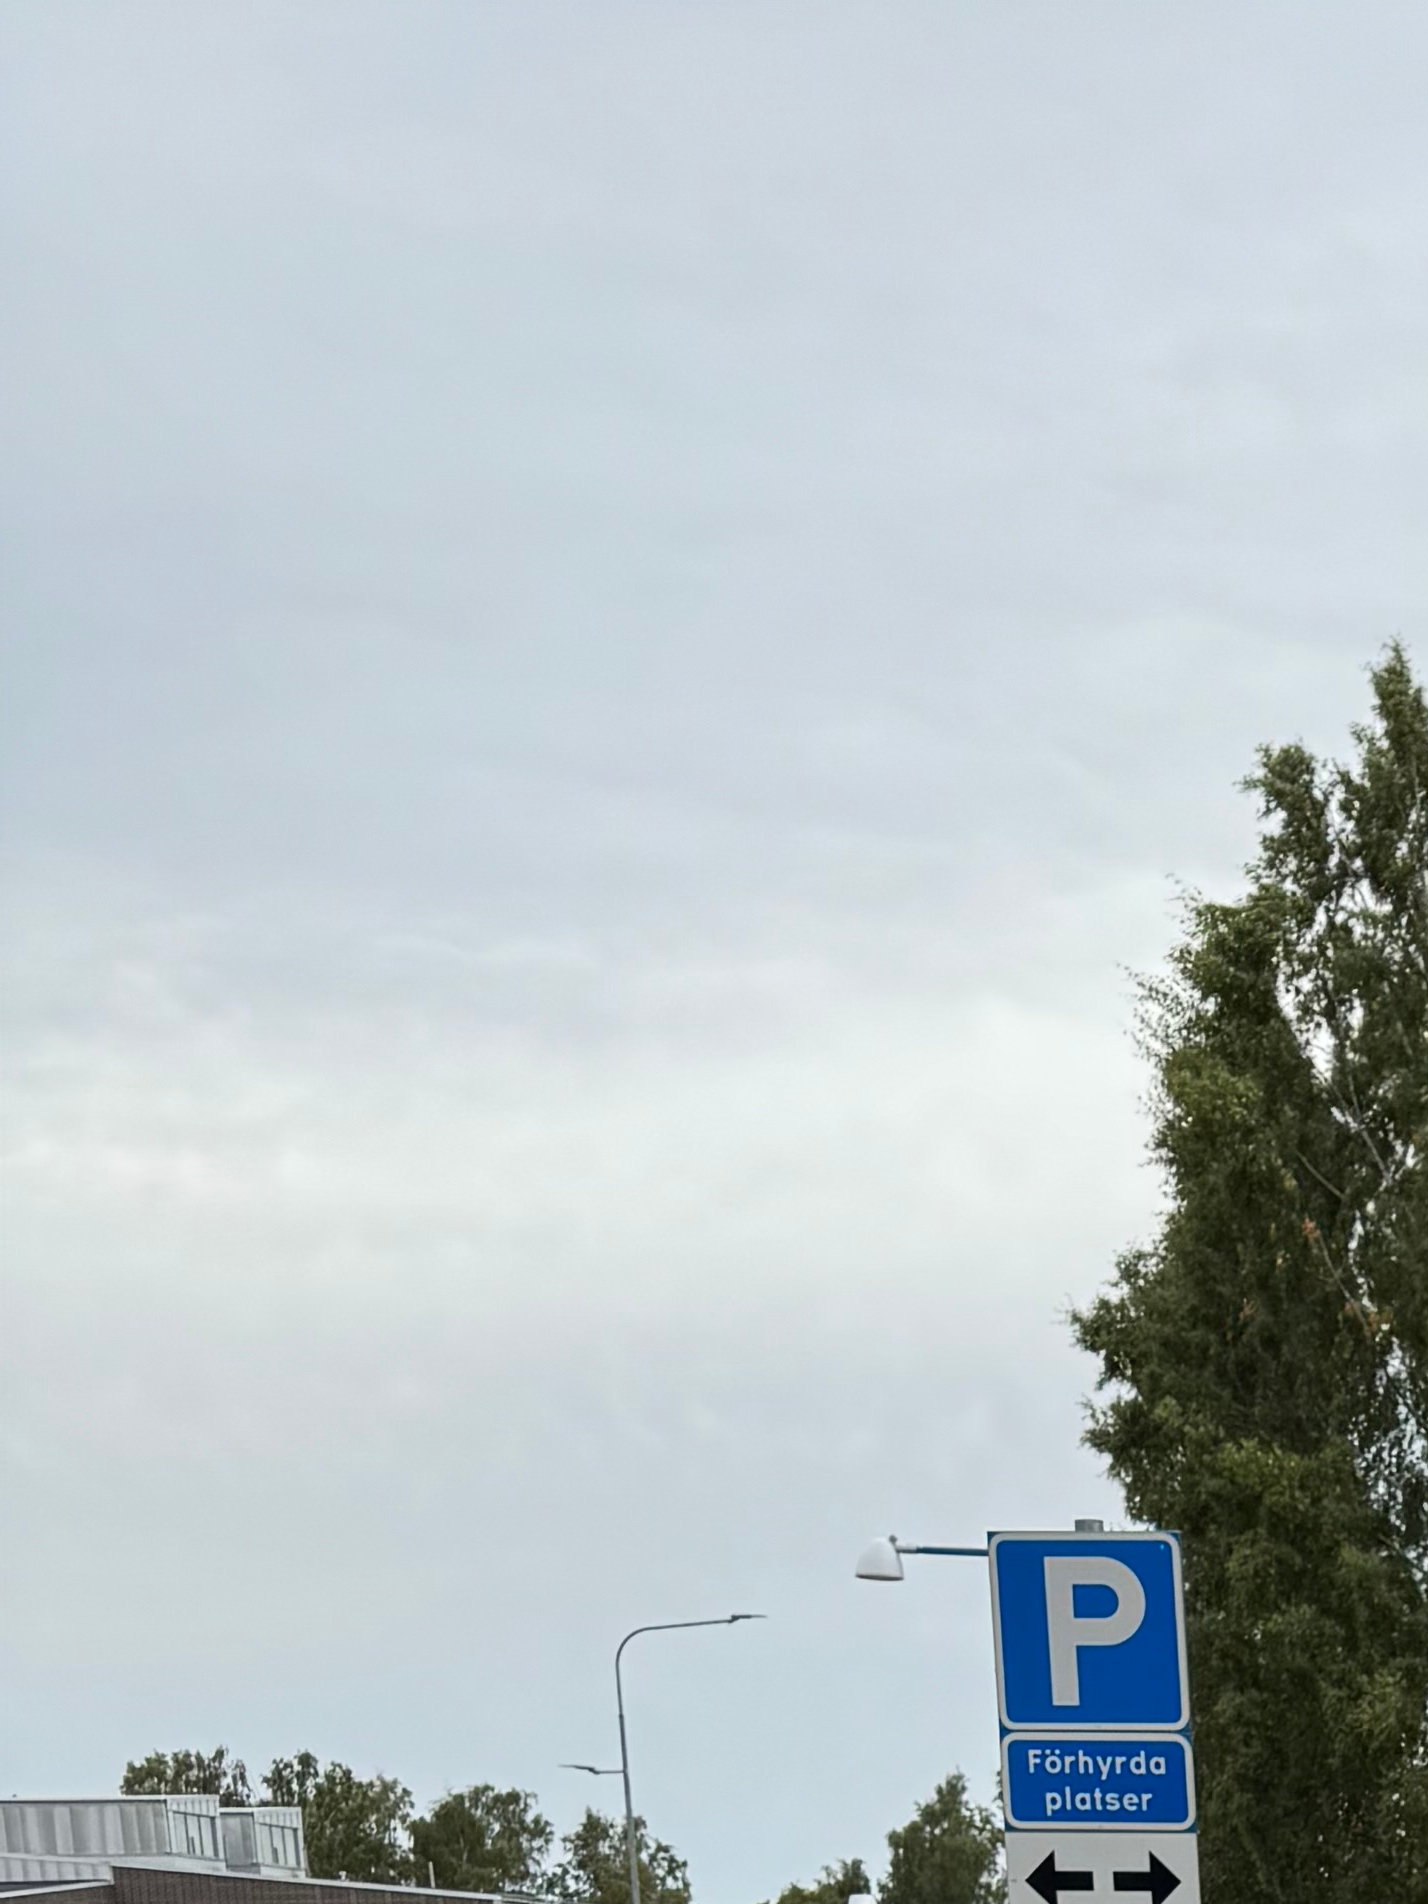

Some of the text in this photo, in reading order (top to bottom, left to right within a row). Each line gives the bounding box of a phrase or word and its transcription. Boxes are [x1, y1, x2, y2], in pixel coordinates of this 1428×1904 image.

[1044, 1556, 1146, 1706] P
[1028, 1749, 1166, 1780] Förhyrda
[1045, 1786, 1153, 1816] platser
